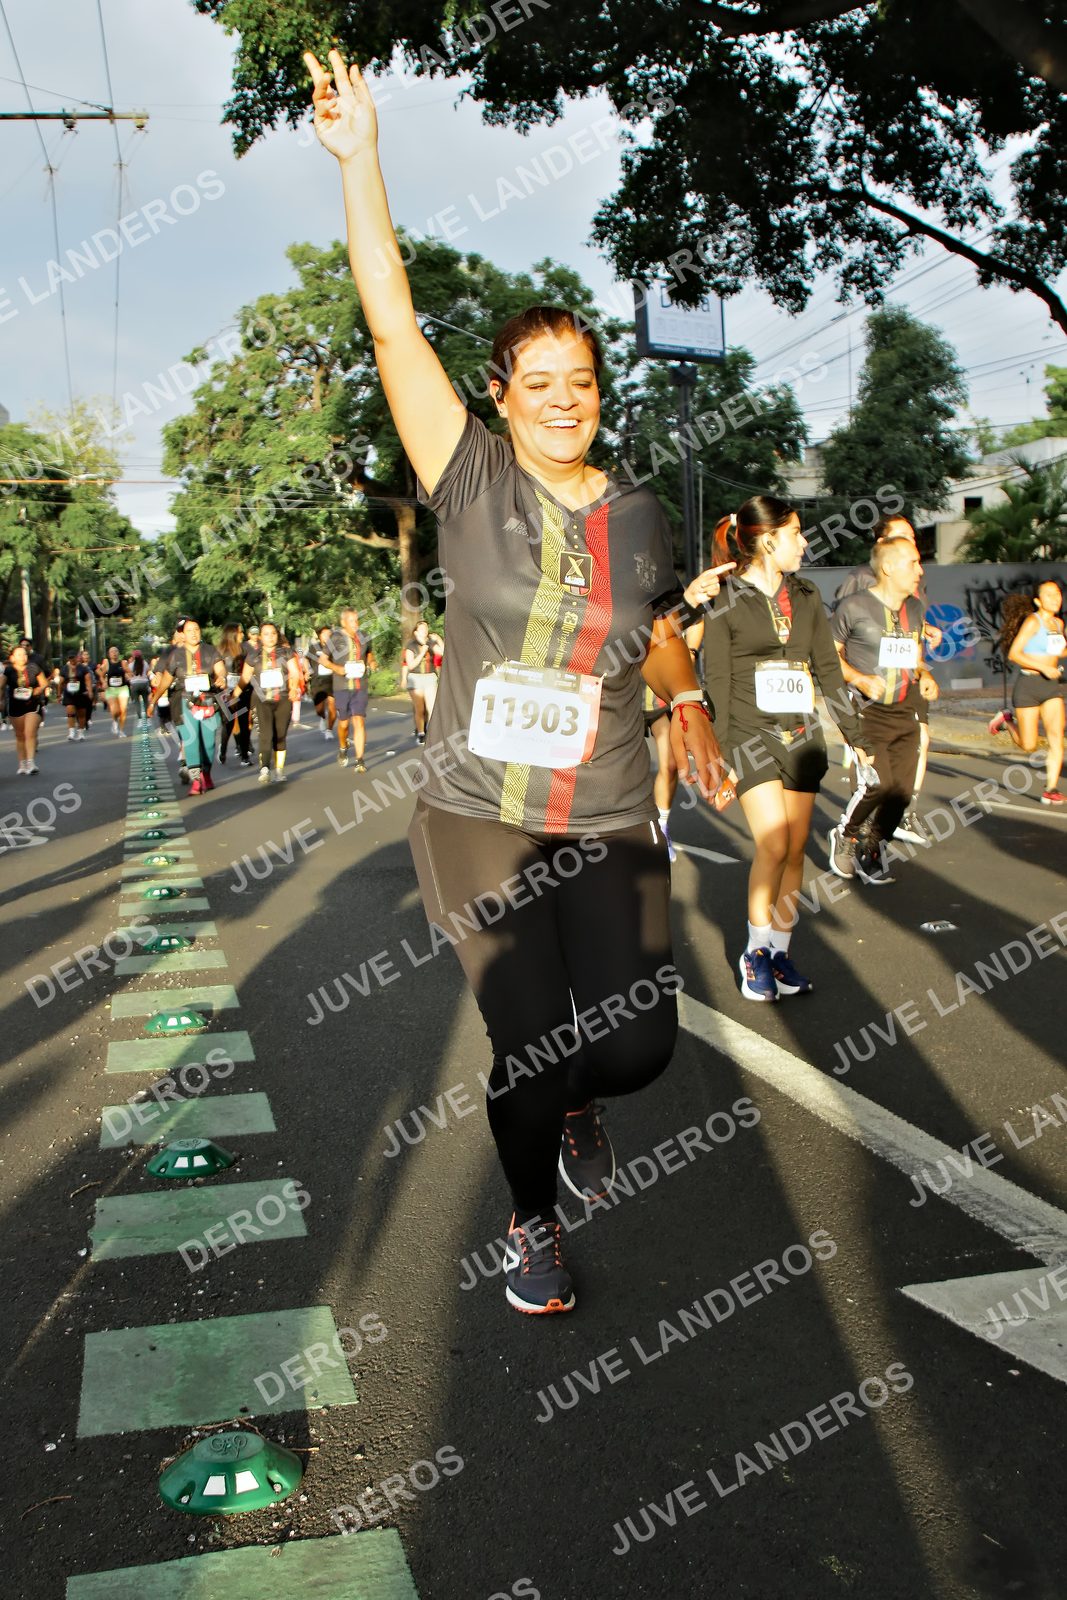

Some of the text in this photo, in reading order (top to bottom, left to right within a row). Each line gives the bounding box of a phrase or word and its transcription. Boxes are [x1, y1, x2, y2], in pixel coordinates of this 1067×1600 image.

[886, 643, 912, 655] 4164
[766, 677, 804, 694] 5206
[481, 693, 580, 737] 11903
